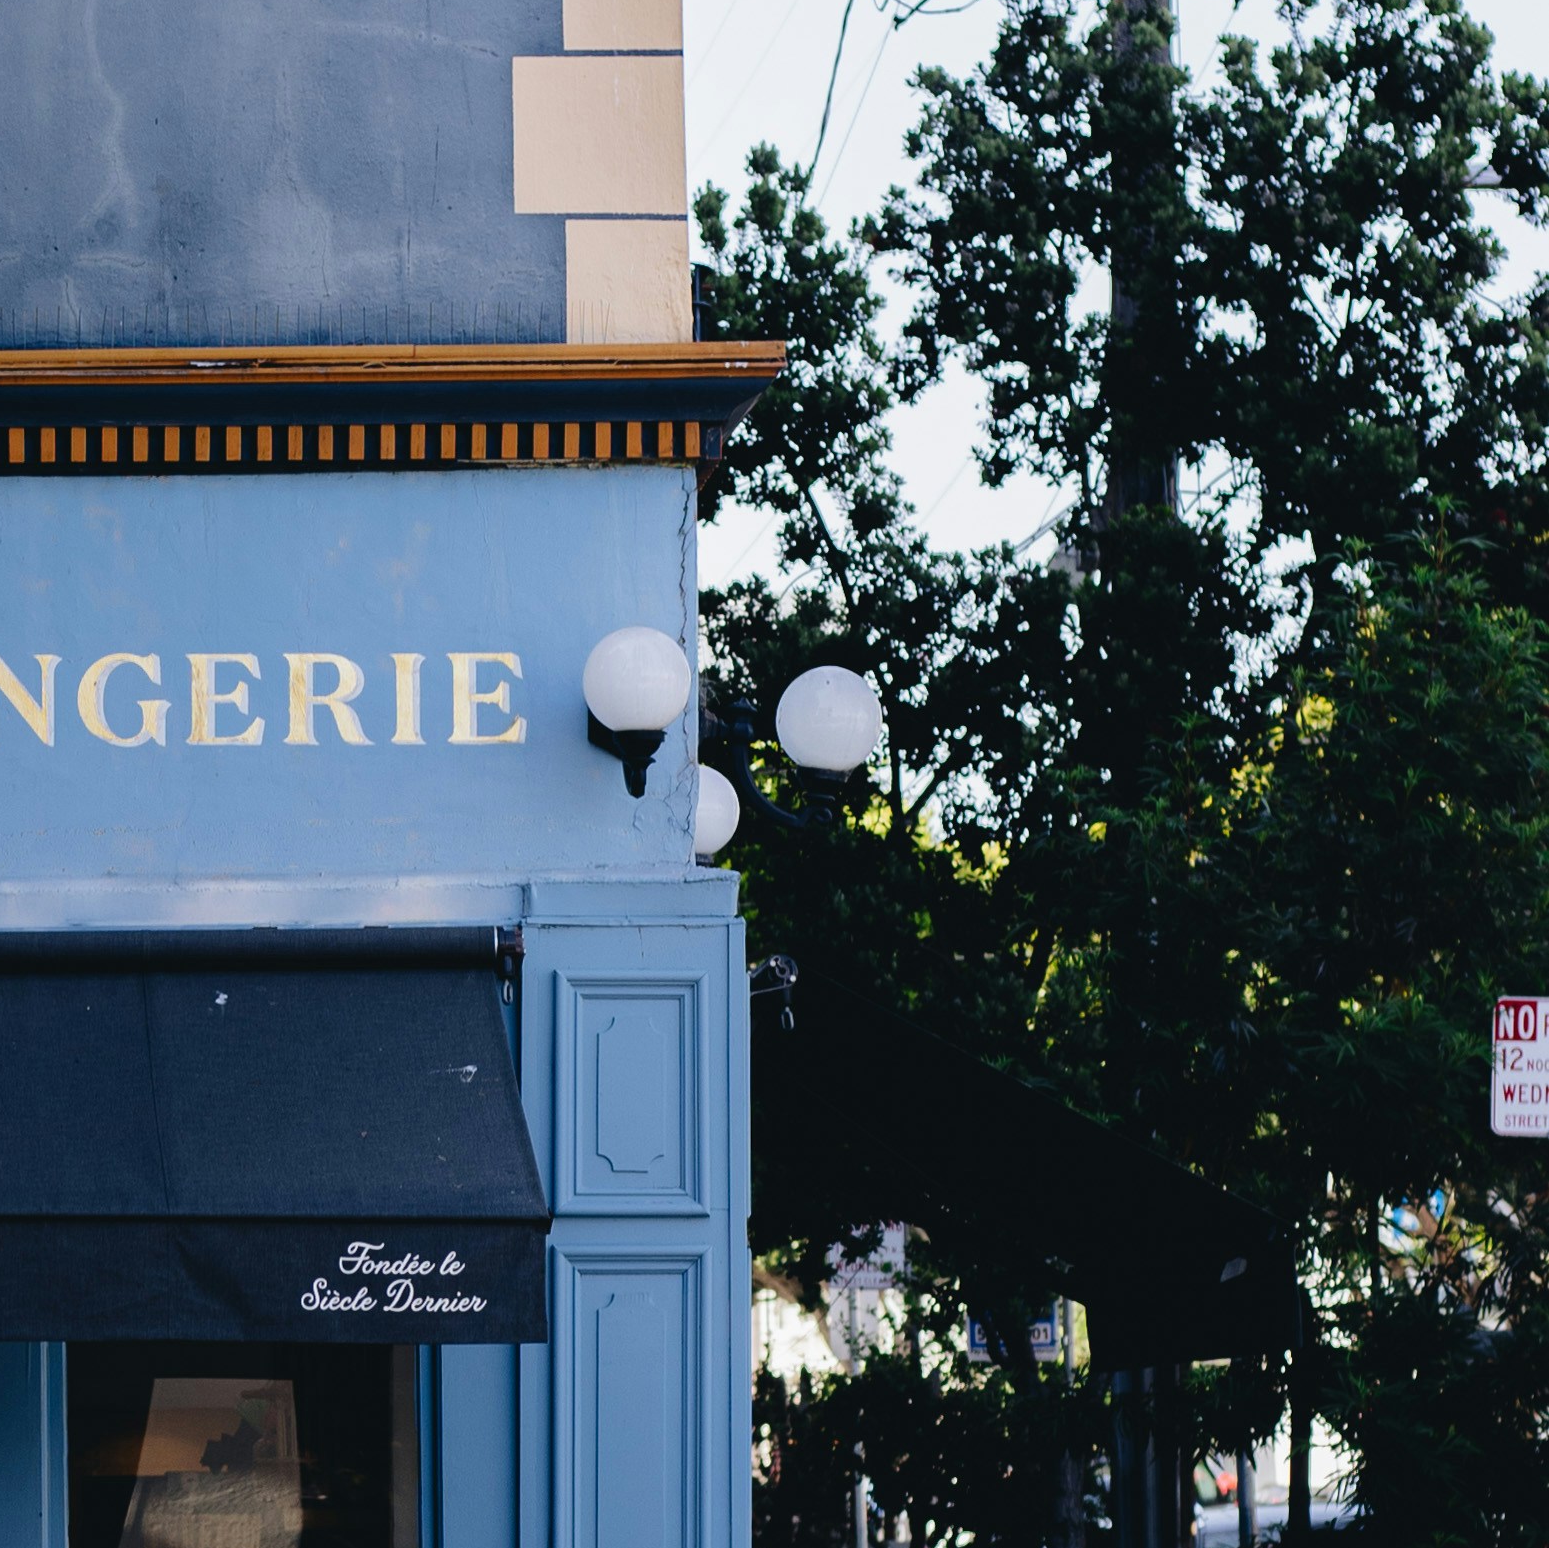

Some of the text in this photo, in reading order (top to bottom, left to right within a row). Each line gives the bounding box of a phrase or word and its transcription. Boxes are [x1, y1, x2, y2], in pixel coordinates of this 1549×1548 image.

[1498, 1004, 1536, 1040] NO
[1502, 1047, 1524, 1071] 12
[339, 1241, 466, 1276] Fondée le
[300, 1277, 488, 1313] Siècle Dernier
